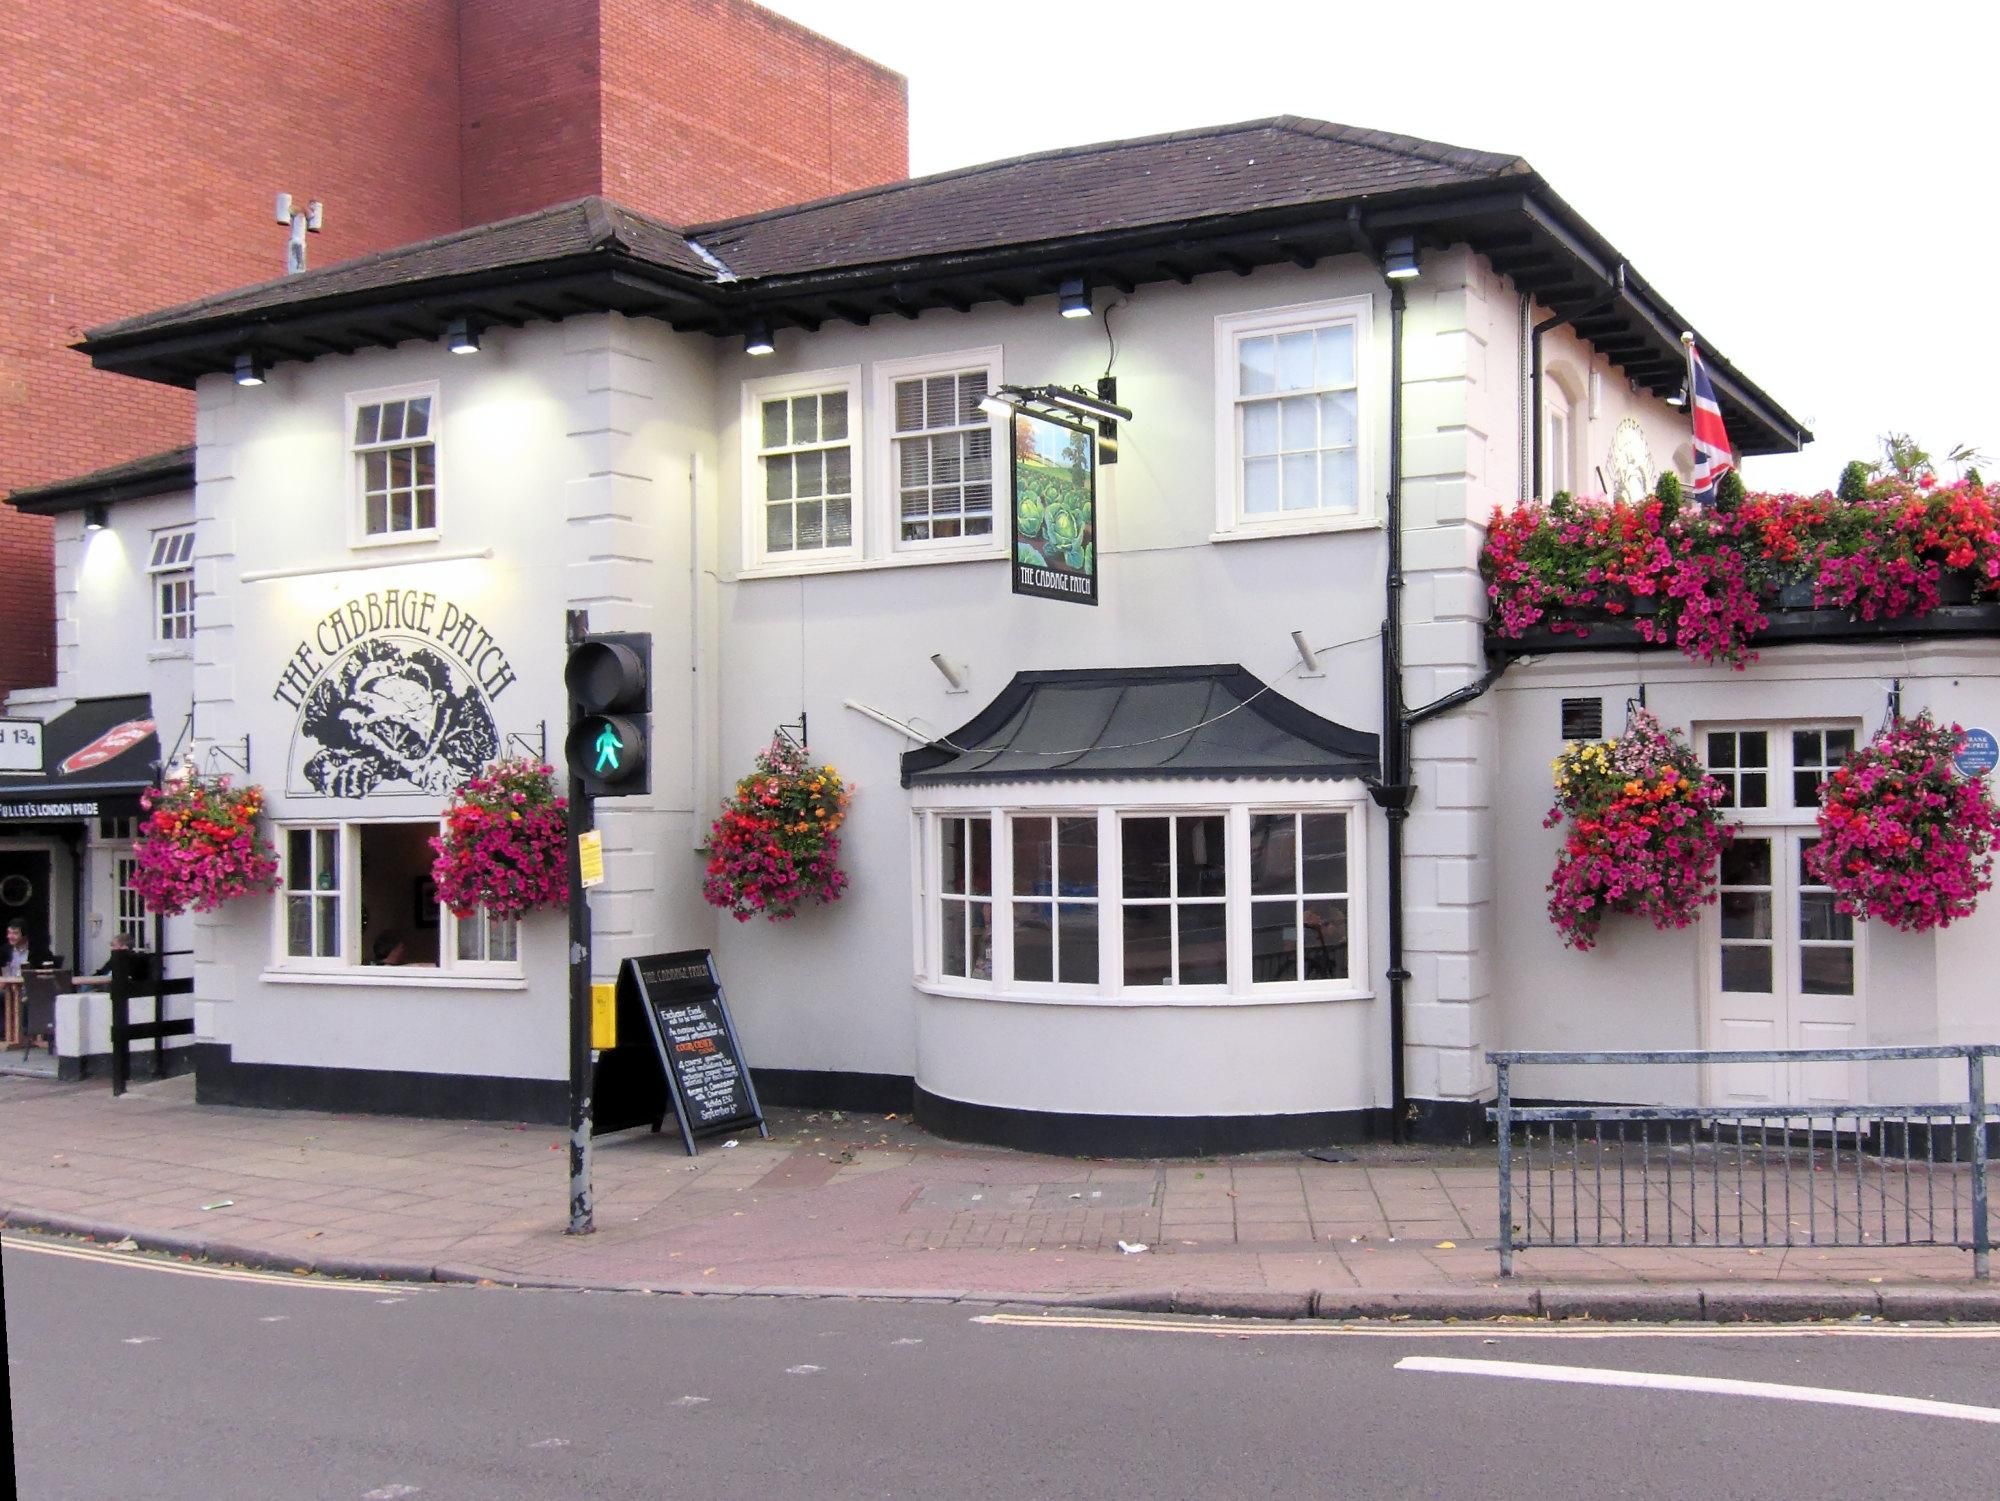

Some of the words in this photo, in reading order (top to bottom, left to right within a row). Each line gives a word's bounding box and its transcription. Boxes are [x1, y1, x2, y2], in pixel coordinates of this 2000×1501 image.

[1021, 567, 1034, 585] THE
[1035, 569, 1069, 591] CABBAGE
[1069, 575, 1091, 595] PATCH
[273, 640, 324, 712] THE
[316, 589, 437, 656] CABBAGE
[435, 602, 517, 703] PATCH
[37, 803, 72, 816] LONDON
[73, 802, 98, 815] PRIDE
[701, 1106, 730, 1120] September
